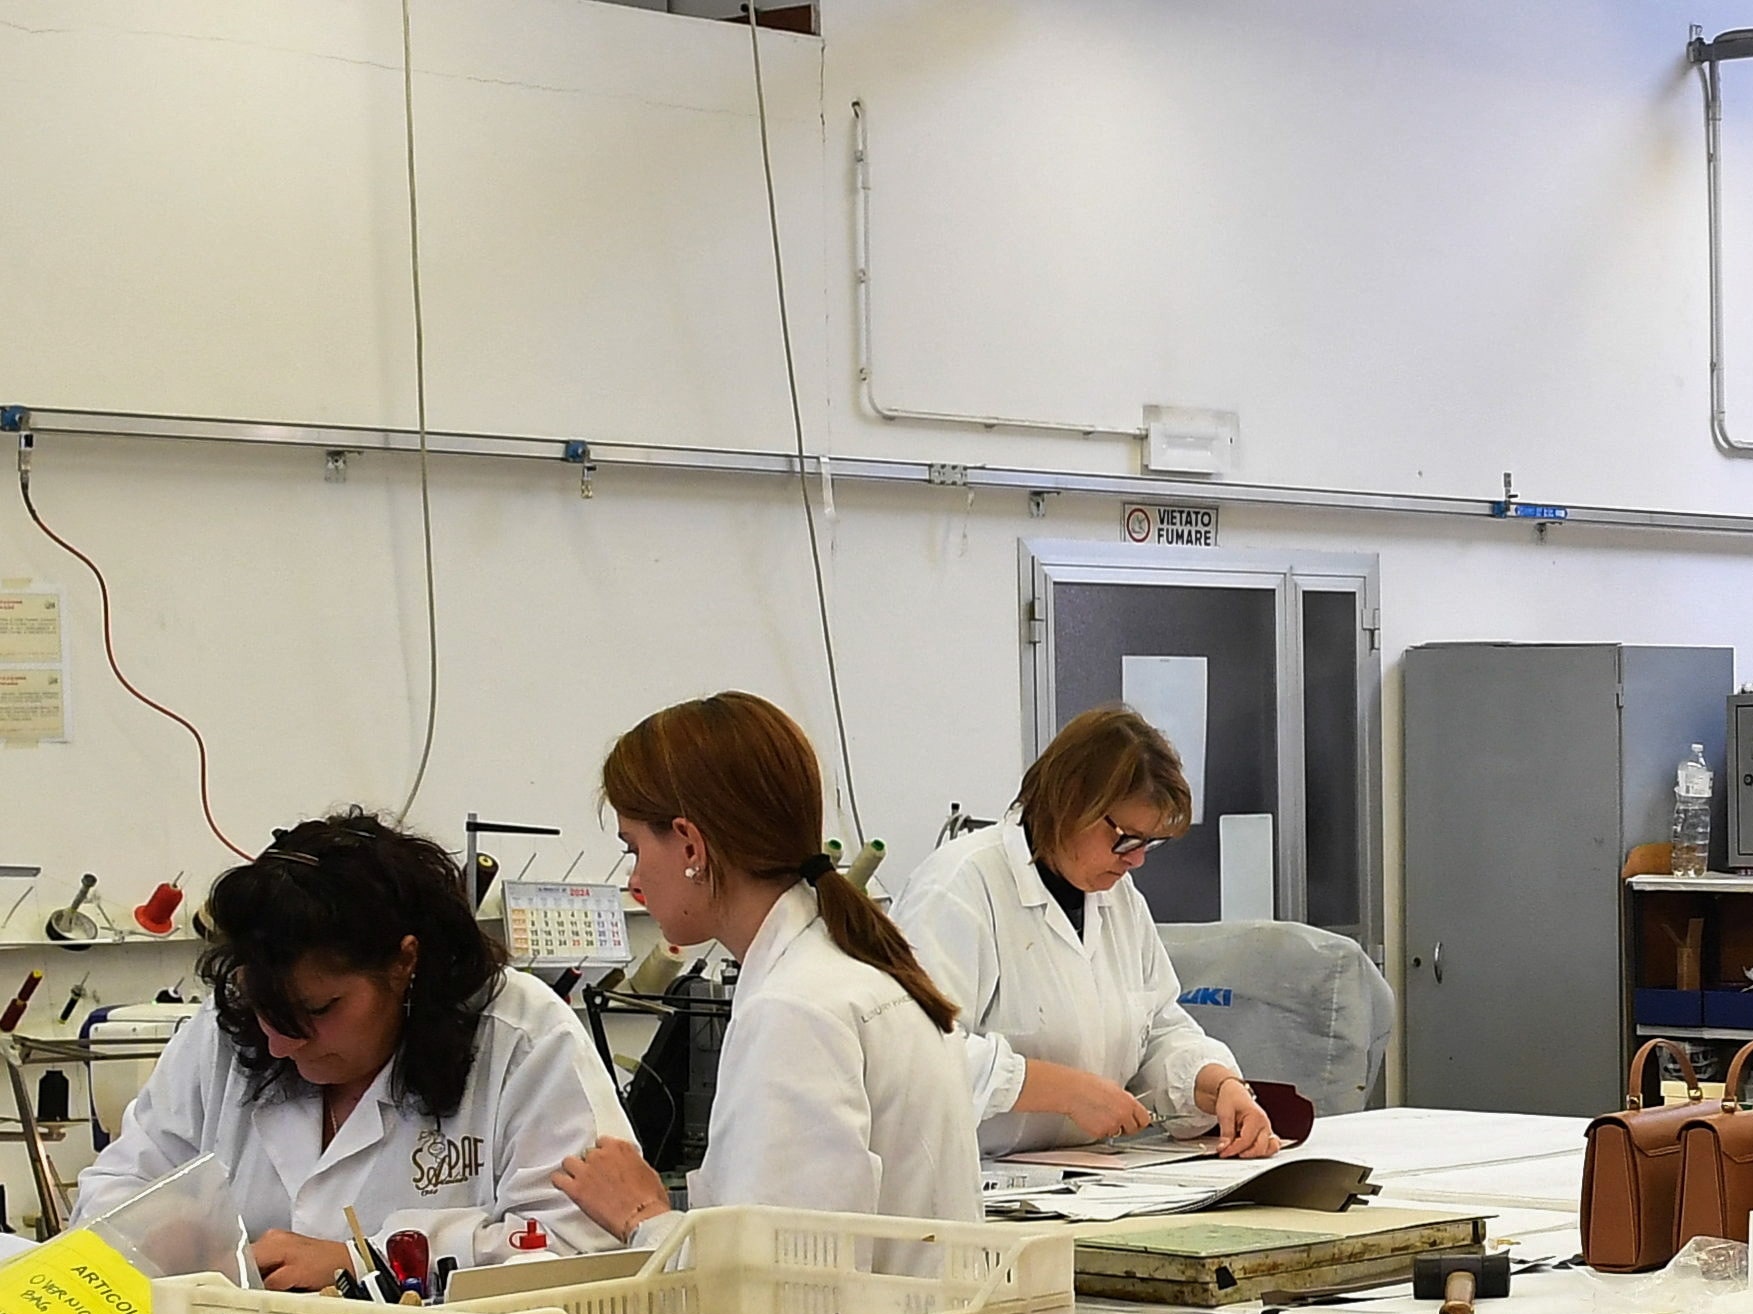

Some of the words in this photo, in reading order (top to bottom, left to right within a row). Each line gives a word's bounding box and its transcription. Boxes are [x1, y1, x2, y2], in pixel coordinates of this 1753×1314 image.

[1157, 508, 1212, 527] VIETATO
[1157, 528, 1211, 547] FUMARE
[20, 1289, 52, 1312] BAG
